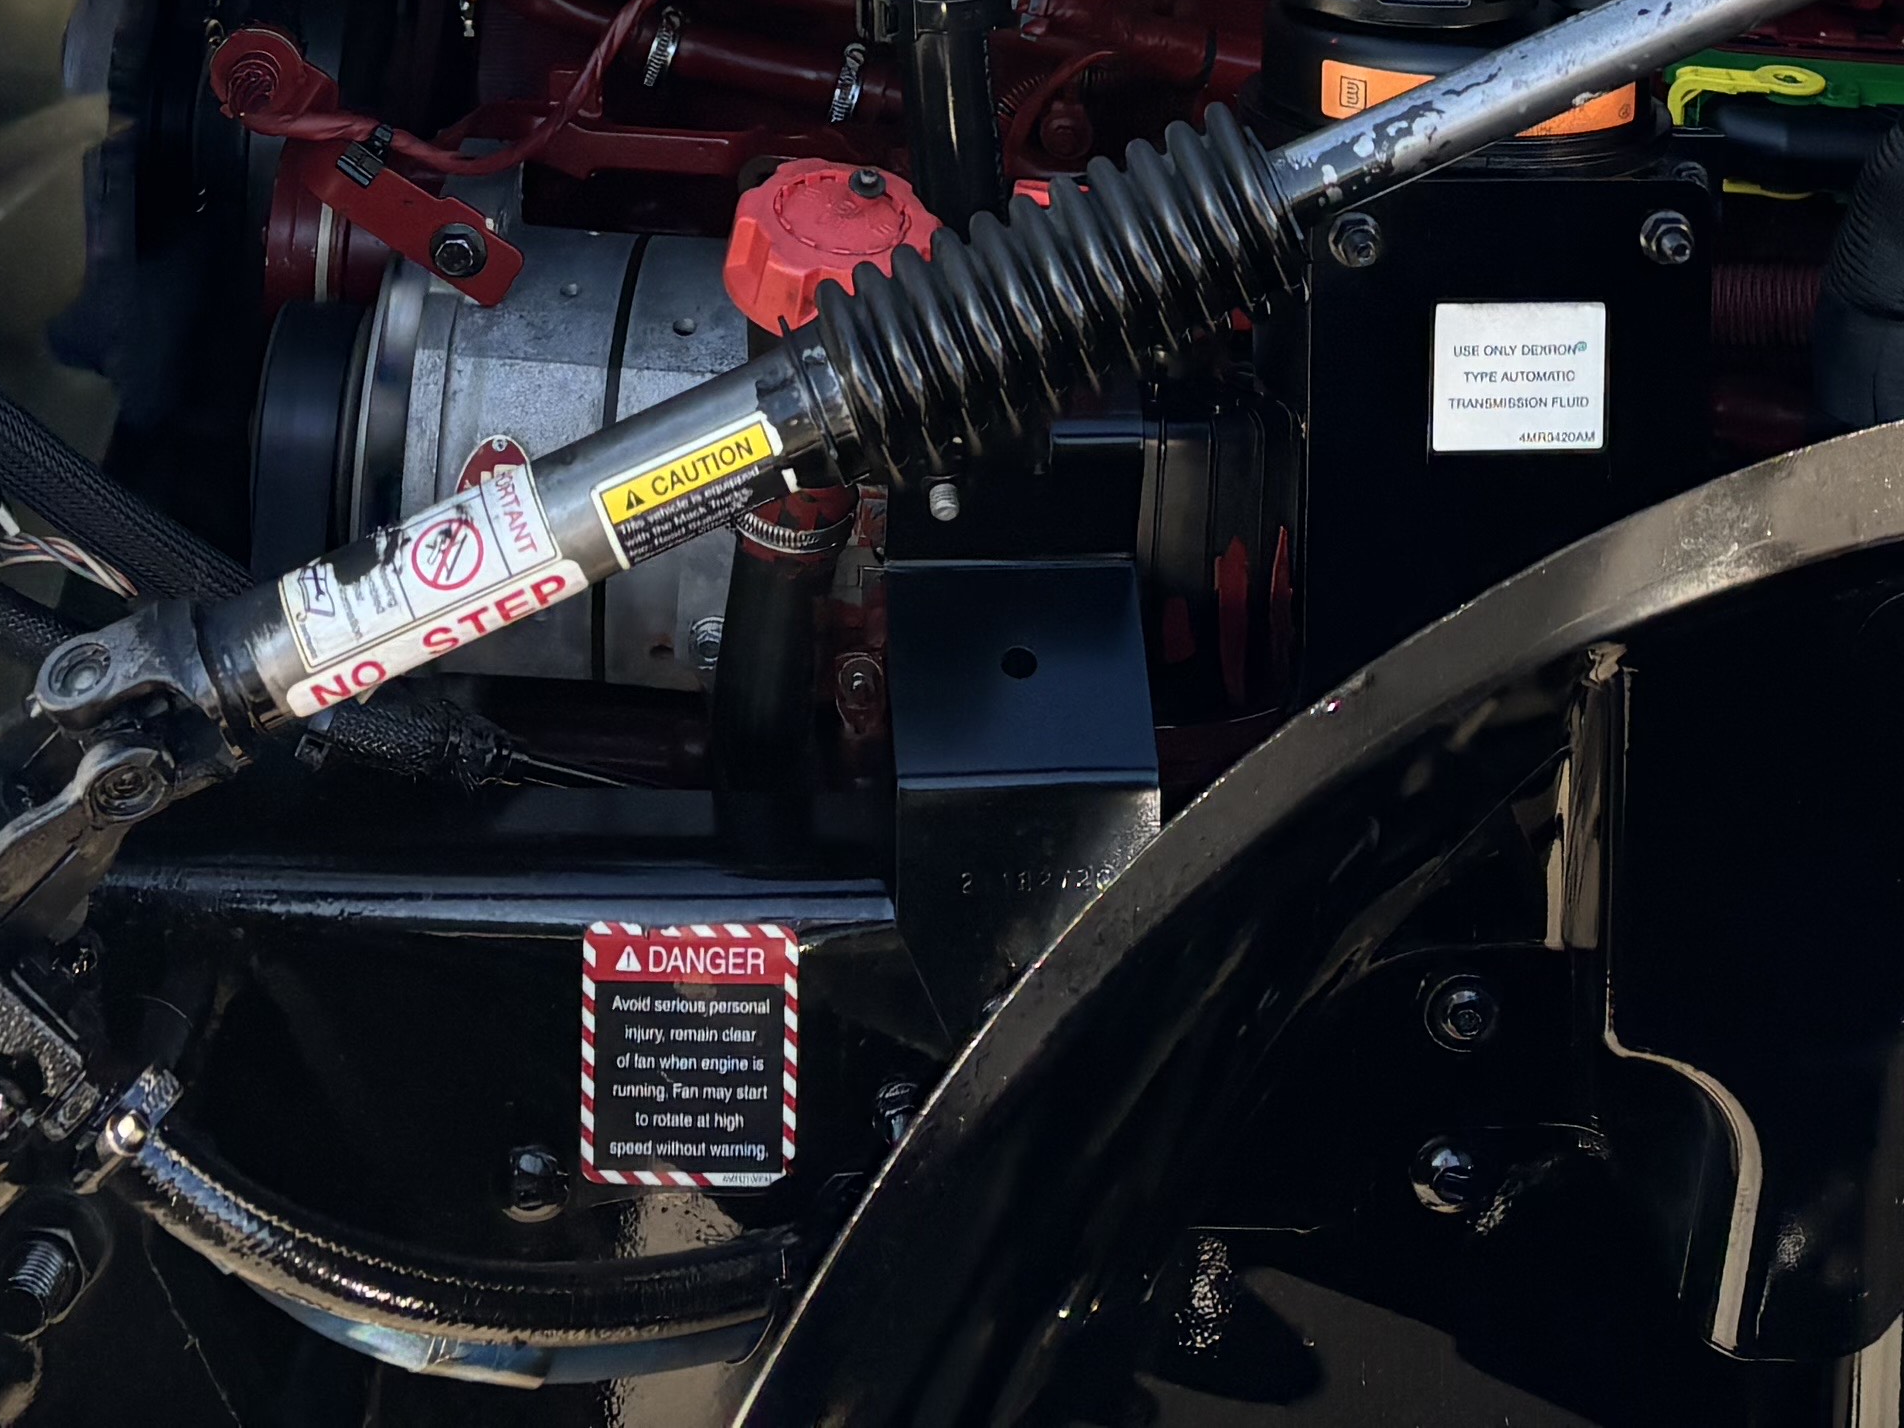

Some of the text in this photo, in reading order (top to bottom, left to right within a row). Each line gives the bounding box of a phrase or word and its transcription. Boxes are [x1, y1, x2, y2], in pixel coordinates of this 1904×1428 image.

[1453, 344, 1480, 358] USE
[1483, 344, 1517, 357] ONLY
[1464, 370, 1575, 383] TYPE AUTOMATIC
[1448, 396, 1589, 410] TRANSMISSION FLUID
[651, 436, 754, 496] CAUTION
[309, 660, 387, 706] NO
[423, 574, 566, 655] STEP
[648, 945, 765, 975] DANGER
[612, 995, 770, 1017] Avoid serious personal
[624, 1024, 757, 1044] injury, remain clear
[616, 1052, 630, 1069] of
[659, 1054, 697, 1071] when
[701, 1055, 749, 1074] engine
[752, 1055, 764, 1071] is
[672, 1082, 699, 1099] Fan
[702, 1086, 733, 1103] may
[736, 1084, 768, 1100] start
[635, 1111, 745, 1132] to rotate at high
[609, 1140, 769, 1161] speed without warning.
